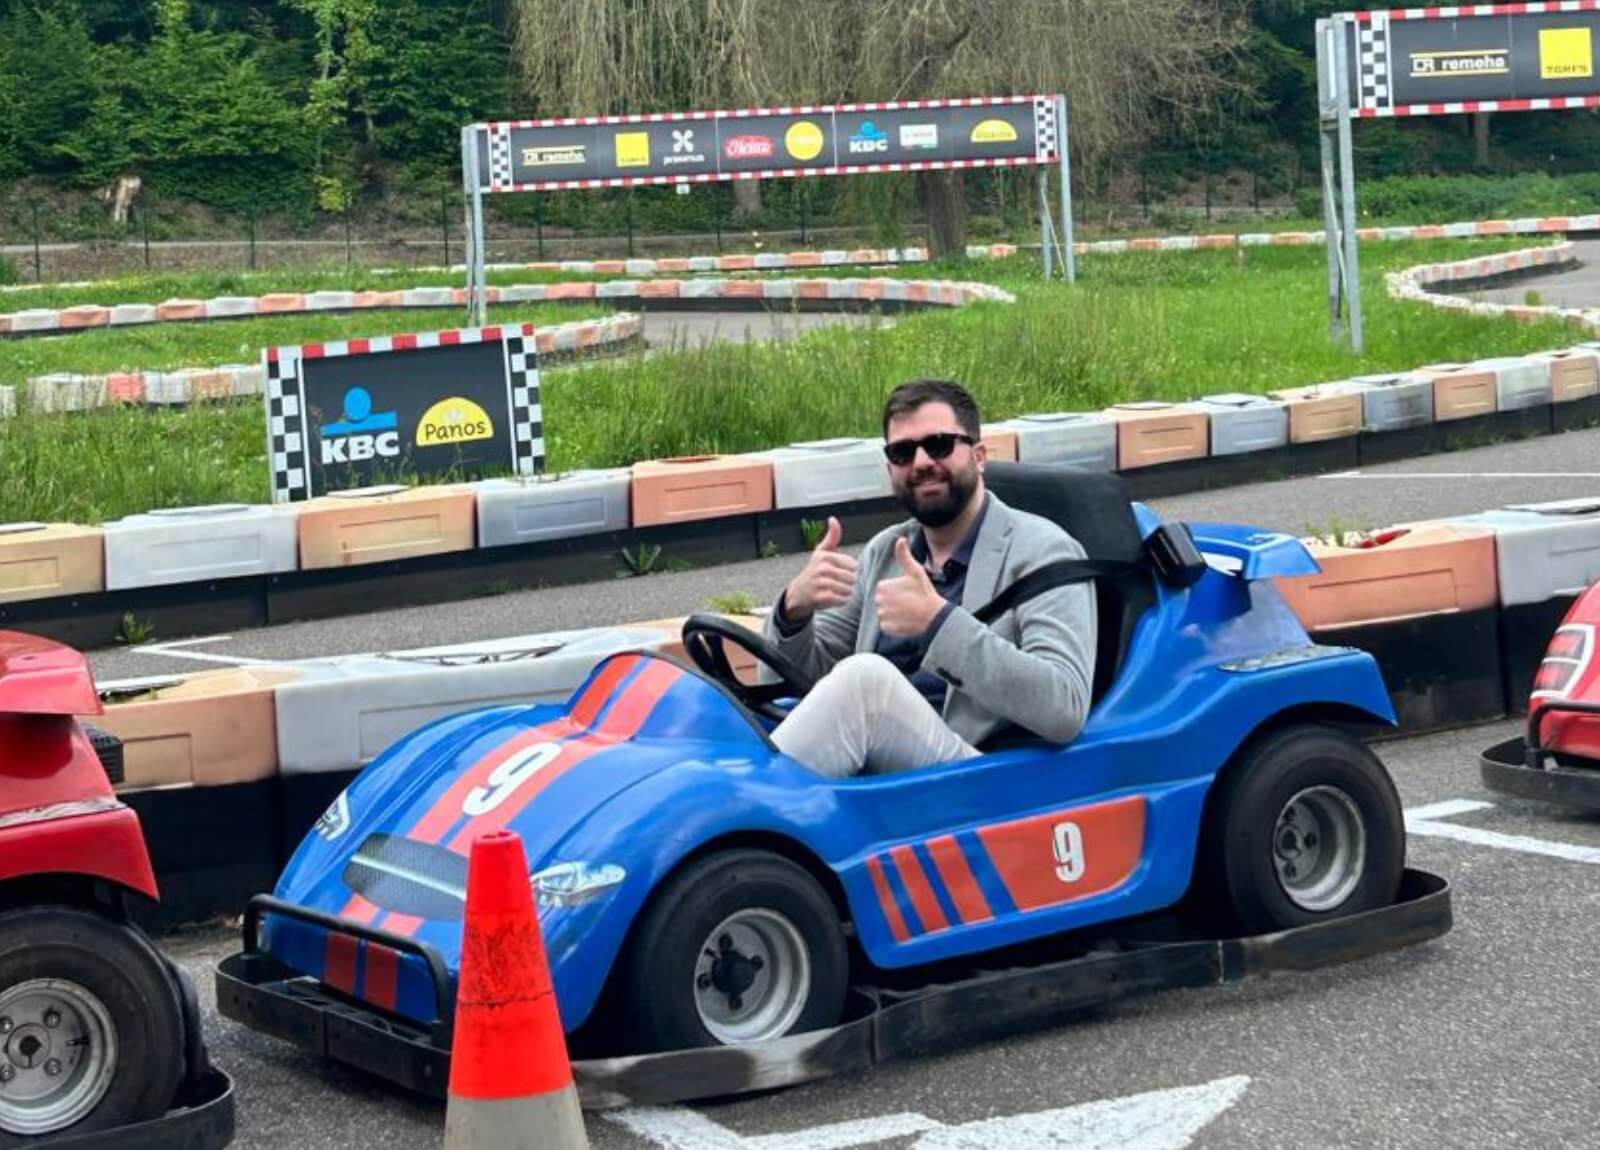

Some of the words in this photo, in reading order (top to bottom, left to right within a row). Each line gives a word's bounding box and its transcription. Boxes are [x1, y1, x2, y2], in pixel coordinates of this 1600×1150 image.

[320, 431, 400, 465] KBC
[424, 421, 487, 441] Panos
[462, 742, 563, 816] 9
[1052, 821, 1085, 883] 9
